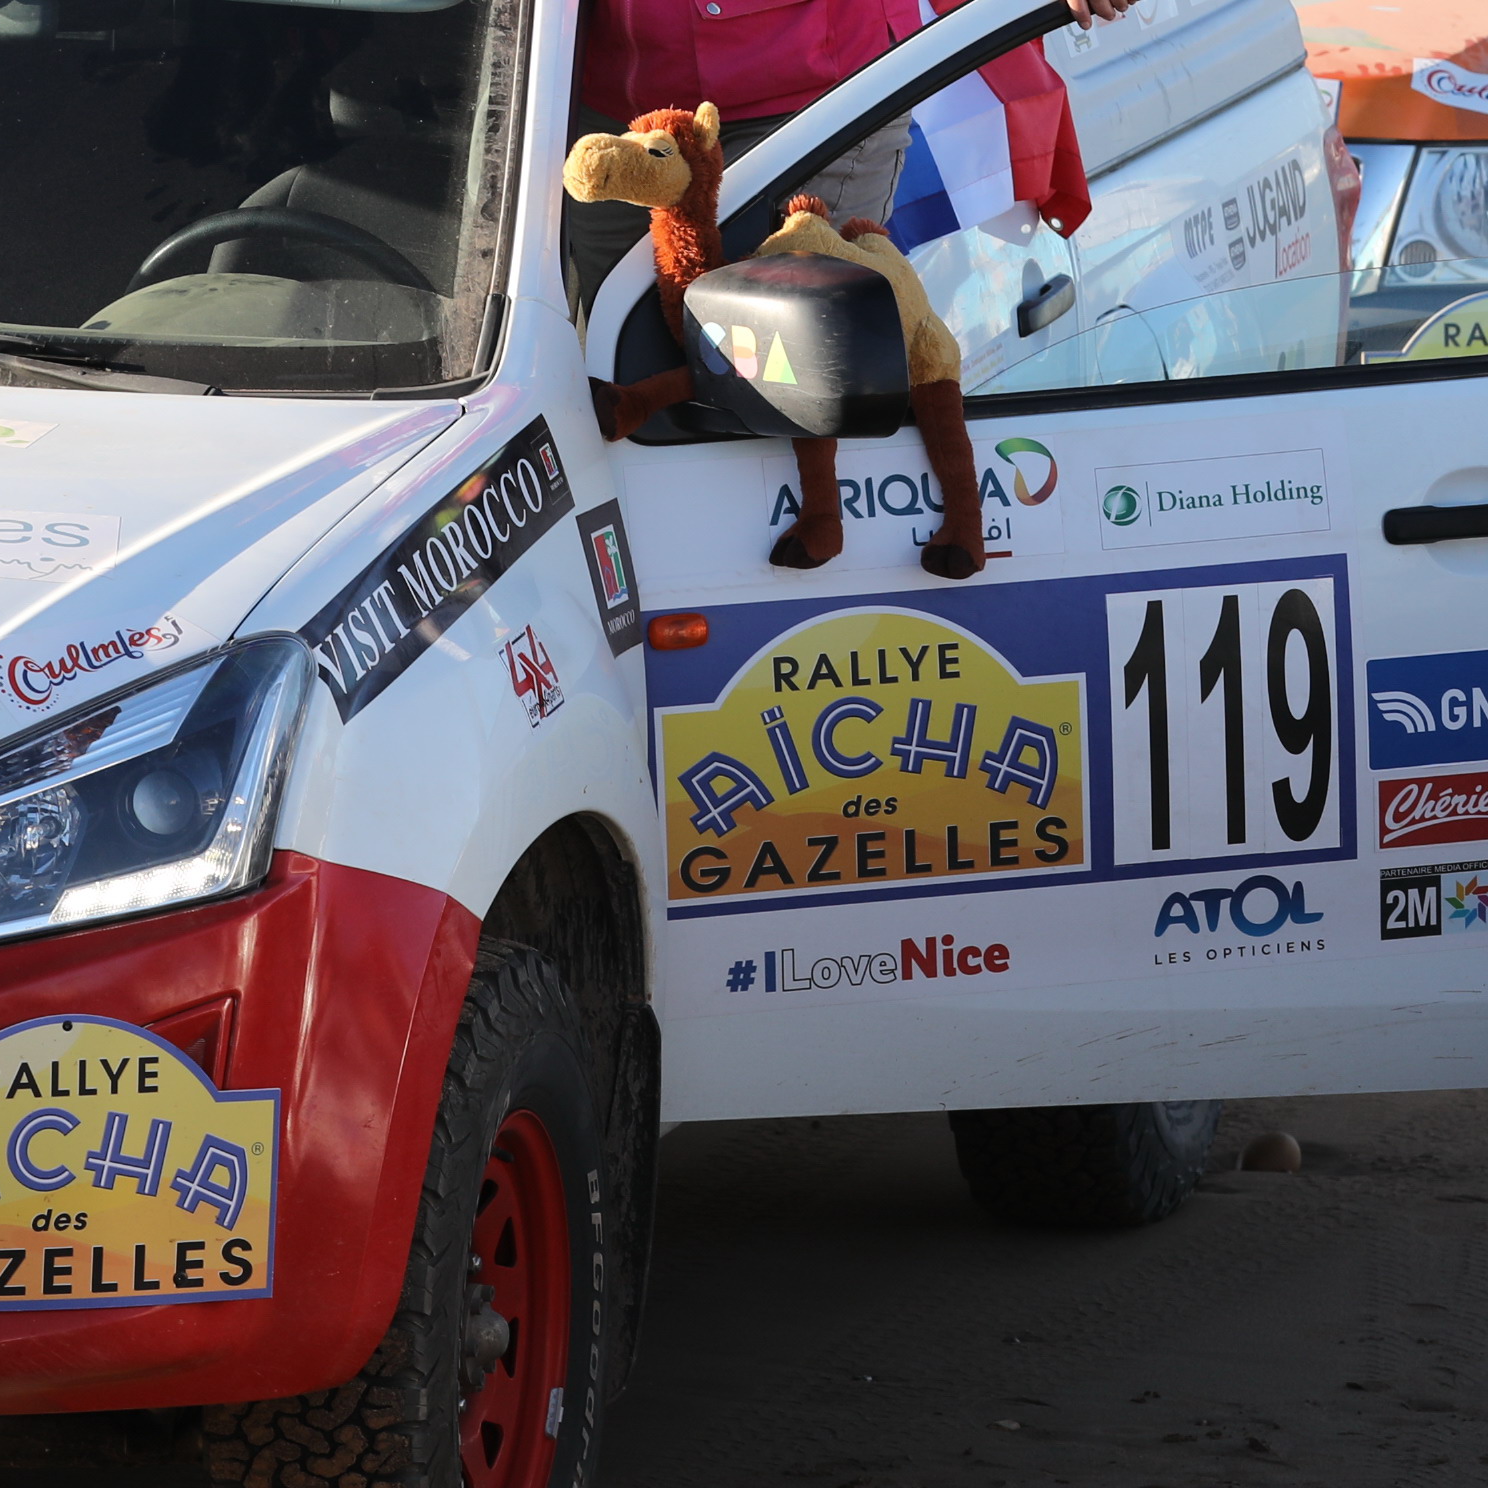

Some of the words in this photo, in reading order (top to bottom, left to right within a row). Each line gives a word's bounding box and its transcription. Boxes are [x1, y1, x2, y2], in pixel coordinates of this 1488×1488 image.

[1246, 159, 1306, 249] JUGAND
[1278, 226, 1311, 276] Location
[1156, 488, 1224, 513] Diana
[1230, 479, 1324, 509] Holding
[312, 579, 411, 696] VISIT
[397, 457, 545, 619] MOROCCO
[607, 609, 635, 635] MOROCCO
[772, 642, 962, 693] RALLYE
[1123, 587, 1334, 851] 119
[841, 794, 900, 821] des
[678, 814, 1073, 894] GAZELLES
[1380, 866, 1432, 878] PARTENAIRE
[1434, 864, 1460, 872] MEDIA
[1152, 873, 1325, 938] ATOL
[1386, 887, 1437, 930] 2M
[725, 933, 1012, 994] #ILoveNice
[1154, 949, 1193, 966] LES
[1206, 938, 1327, 961] OPTICIENS
[30, 1207, 89, 1235] des
